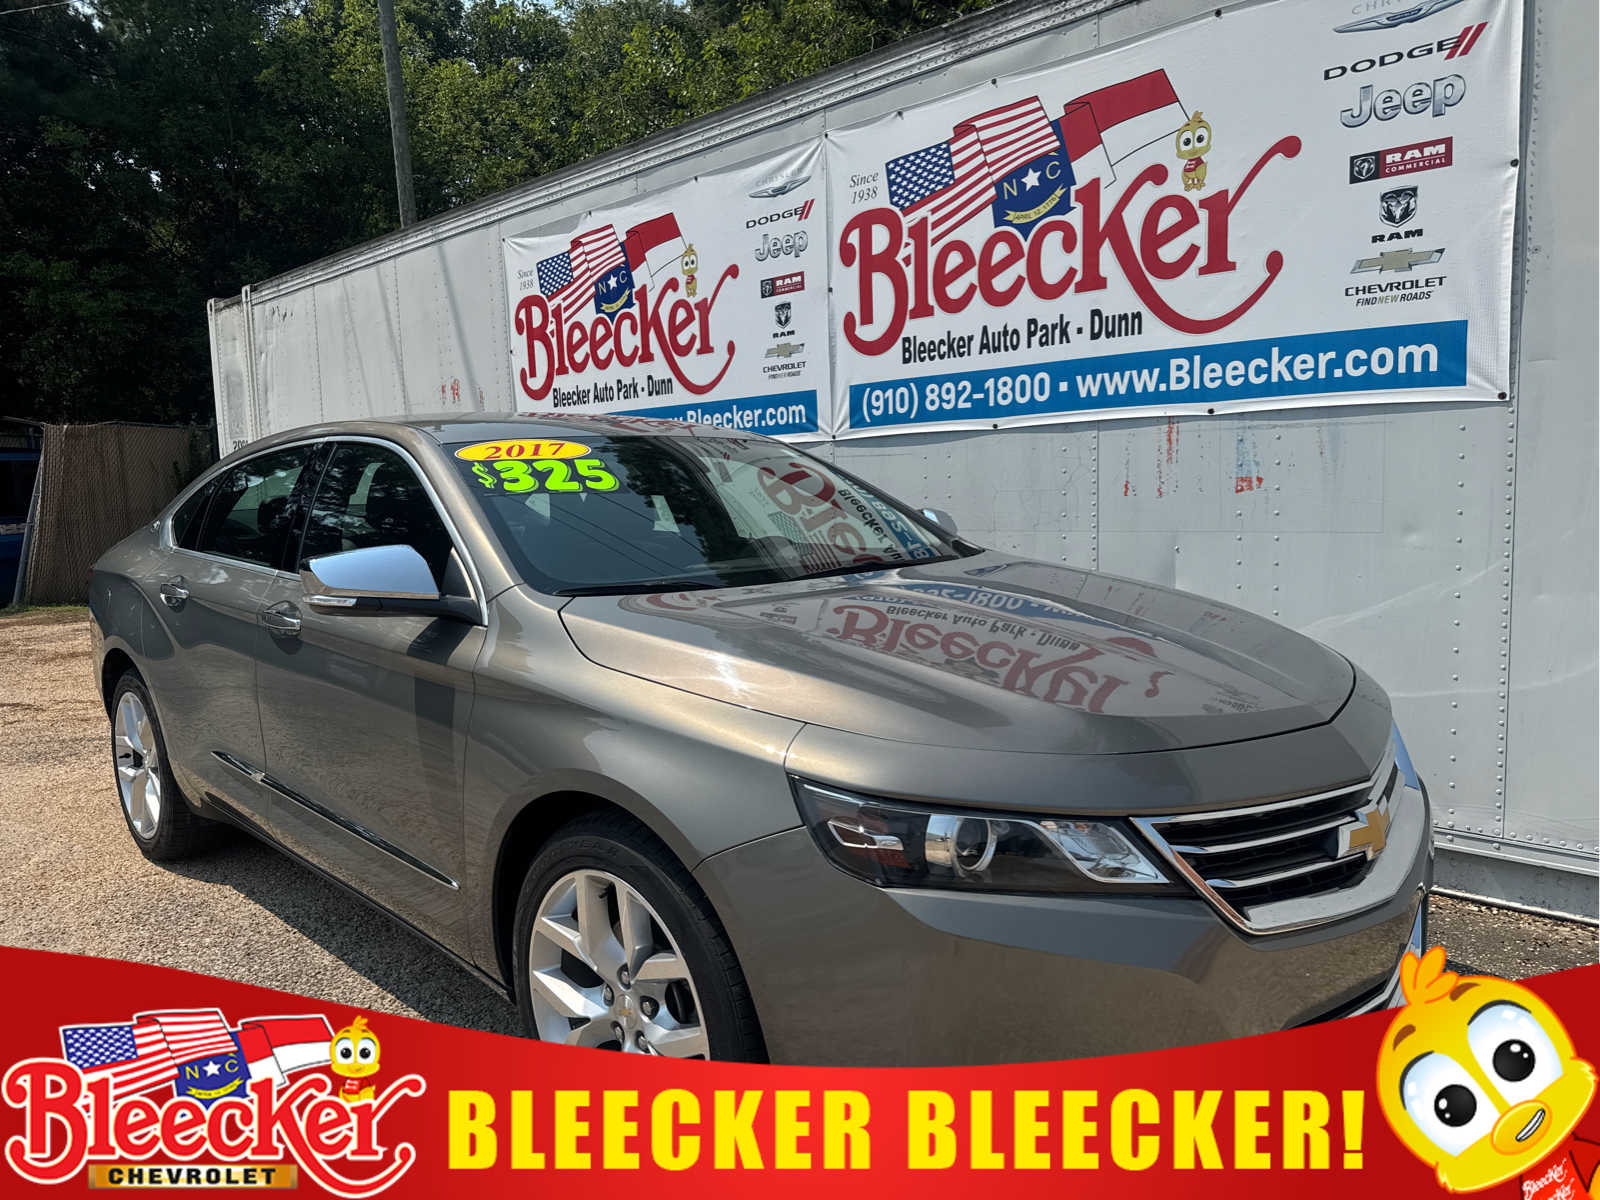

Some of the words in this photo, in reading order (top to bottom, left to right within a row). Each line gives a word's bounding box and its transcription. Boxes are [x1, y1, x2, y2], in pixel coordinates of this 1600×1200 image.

[1323, 35, 1462, 81] DODGE
[1340, 73, 1466, 128] Jeep
[1385, 157, 1446, 173] COMMERCIAL
[1386, 143, 1446, 164] RAM
[850, 172, 879, 188] Since
[1003, 178, 1018, 200] N
[1046, 161, 1061, 179] C
[850, 186, 879, 204] 1938
[745, 206, 805, 229] DODGE
[754, 230, 809, 261] Jeep
[839, 135, 1302, 356] Bleecker
[1371, 228, 1424, 243] RAM
[776, 275, 802, 287] RAM
[1344, 276, 1447, 297] CHEVROLET
[515, 264, 739, 402] Bleecker
[772, 330, 796, 339] RAM
[902, 330, 974, 364] Bleecker
[978, 322, 1020, 355] Auto
[1026, 313, 1071, 349] Park
[1090, 308, 1143, 341] Dunn
[762, 361, 806, 374] CHEVROLET
[552, 384, 591, 408] Bleecker
[593, 382, 615, 403] Auto
[616, 376, 639, 401] Park
[647, 374, 673, 397] Dunn
[862, 387, 918, 422] (910)
[925, 371, 1050, 411] 892-1800
[1076, 343, 1438, 399] www.Bleecker.com
[484, 442, 566, 460] 2017
[471, 459, 620, 492] $325
